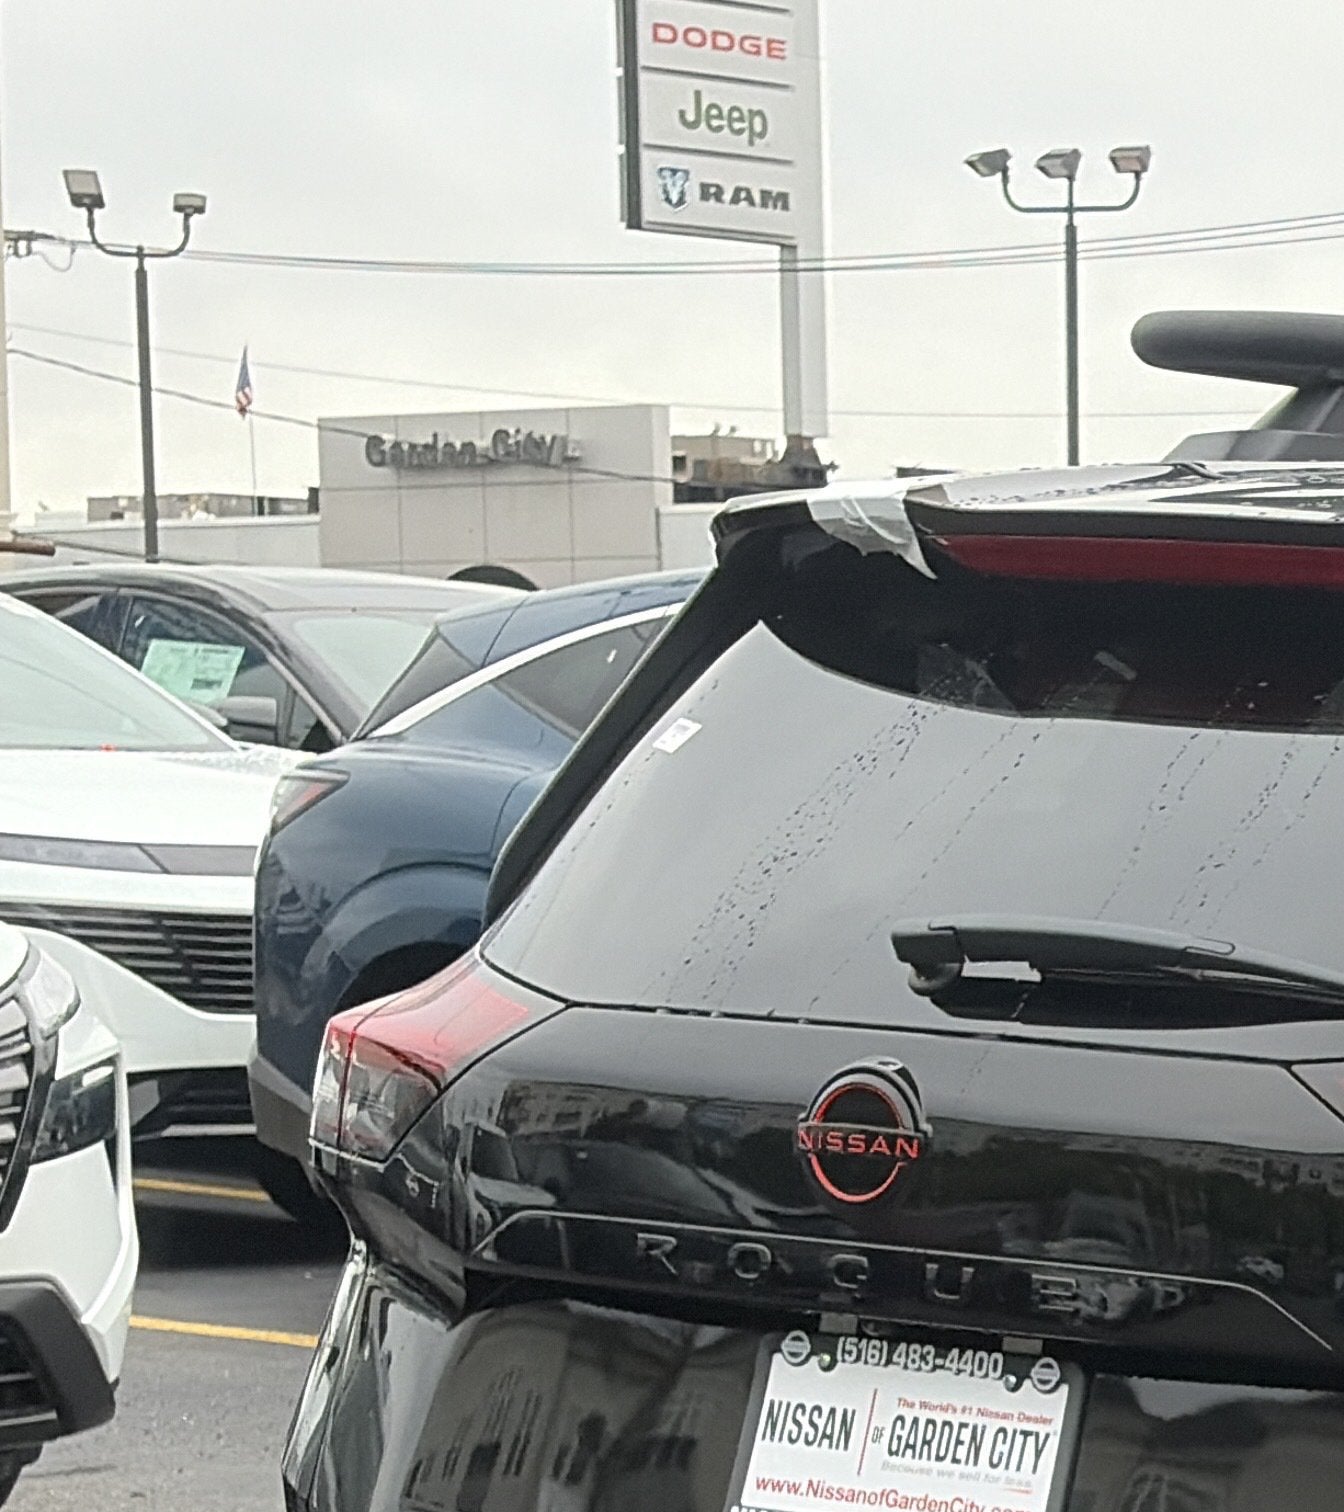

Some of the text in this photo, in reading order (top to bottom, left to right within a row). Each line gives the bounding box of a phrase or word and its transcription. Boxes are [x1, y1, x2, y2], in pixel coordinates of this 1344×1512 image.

[652, 22, 787, 60] DODGE
[678, 89, 768, 147] Jeep
[698, 181, 790, 212] RAM
[366, 432, 475, 467] Garden
[797, 1129, 920, 1160] NISSAN
[636, 1231, 1078, 1313] ROGUE
[836, 1335, 1004, 1380] (516) 483-4400
[761, 1398, 1051, 1476] NISSAN OF GARDEN CITY
